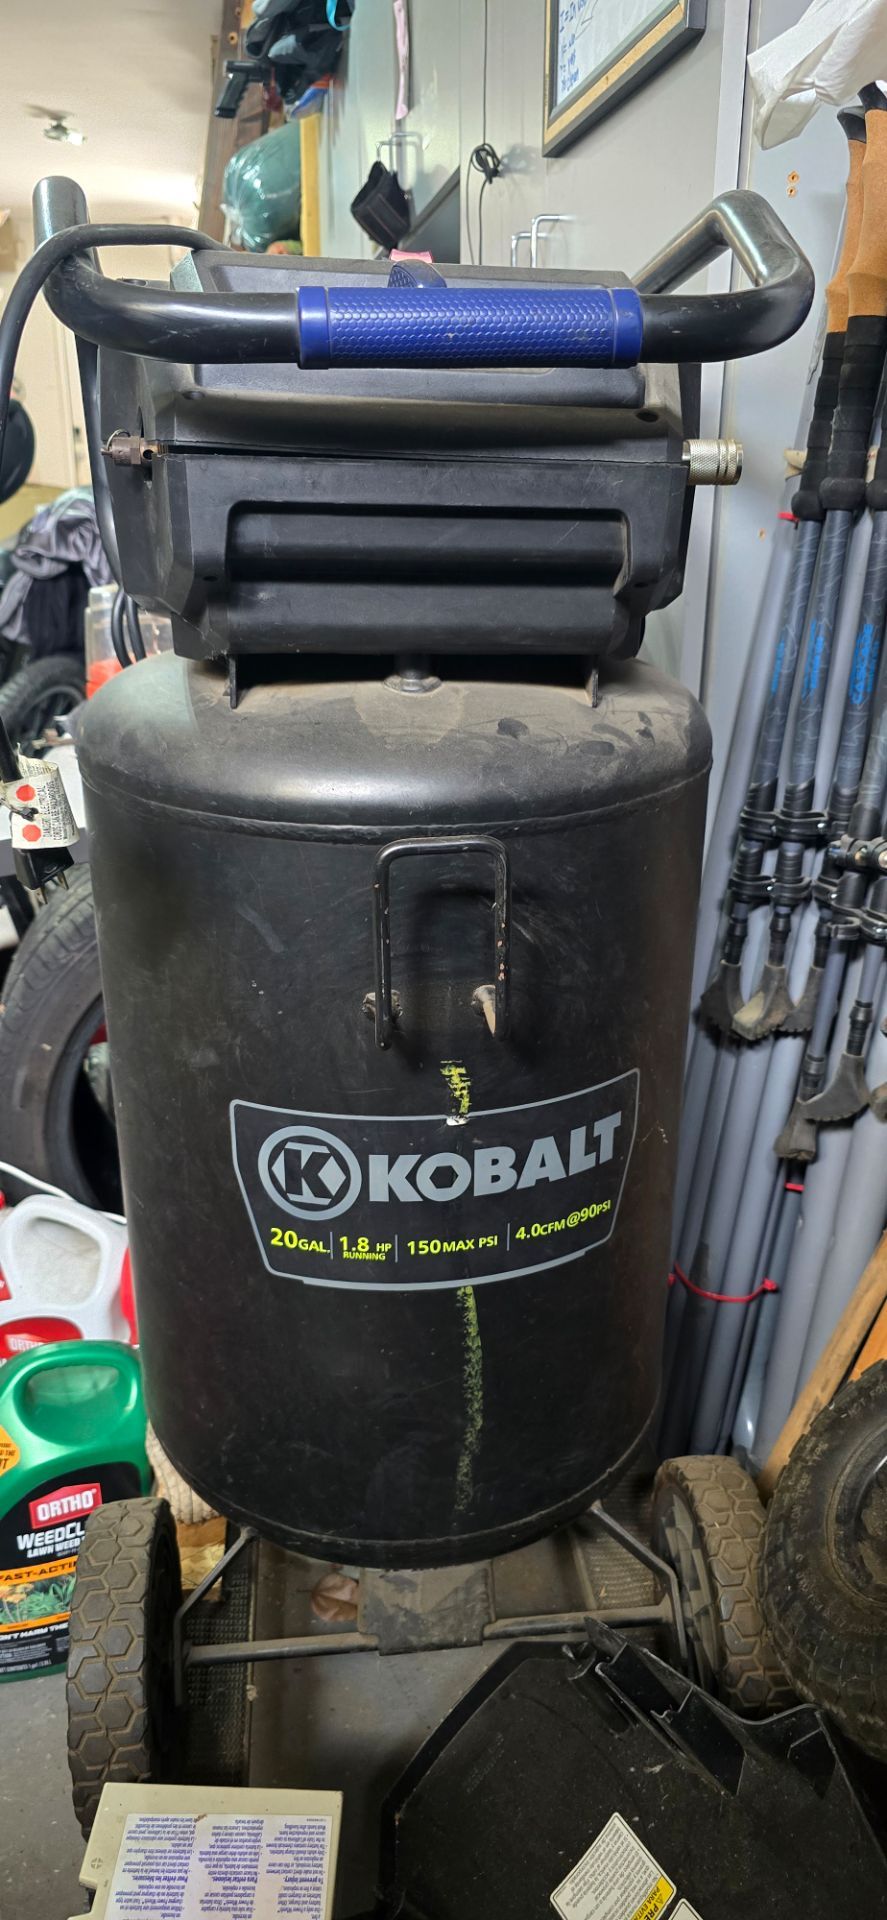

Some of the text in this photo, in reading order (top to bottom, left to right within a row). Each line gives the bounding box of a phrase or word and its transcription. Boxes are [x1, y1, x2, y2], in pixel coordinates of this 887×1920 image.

[368, 1111, 622, 1202] KOBALT
[339, 1236, 370, 1253] 1.8
[376, 1242, 392, 1253] HP
[479, 1235, 498, 1248] PSI
[343, 1251, 386, 1261] RUNNING
[36, 1491, 94, 1522] ORTHO
[27, 1544, 54, 1559] LAWN
[55, 1538, 81, 1553] WEED
[0, 1560, 77, 1582] AST-ACTI
[646, 1886, 662, 1905] PARA
